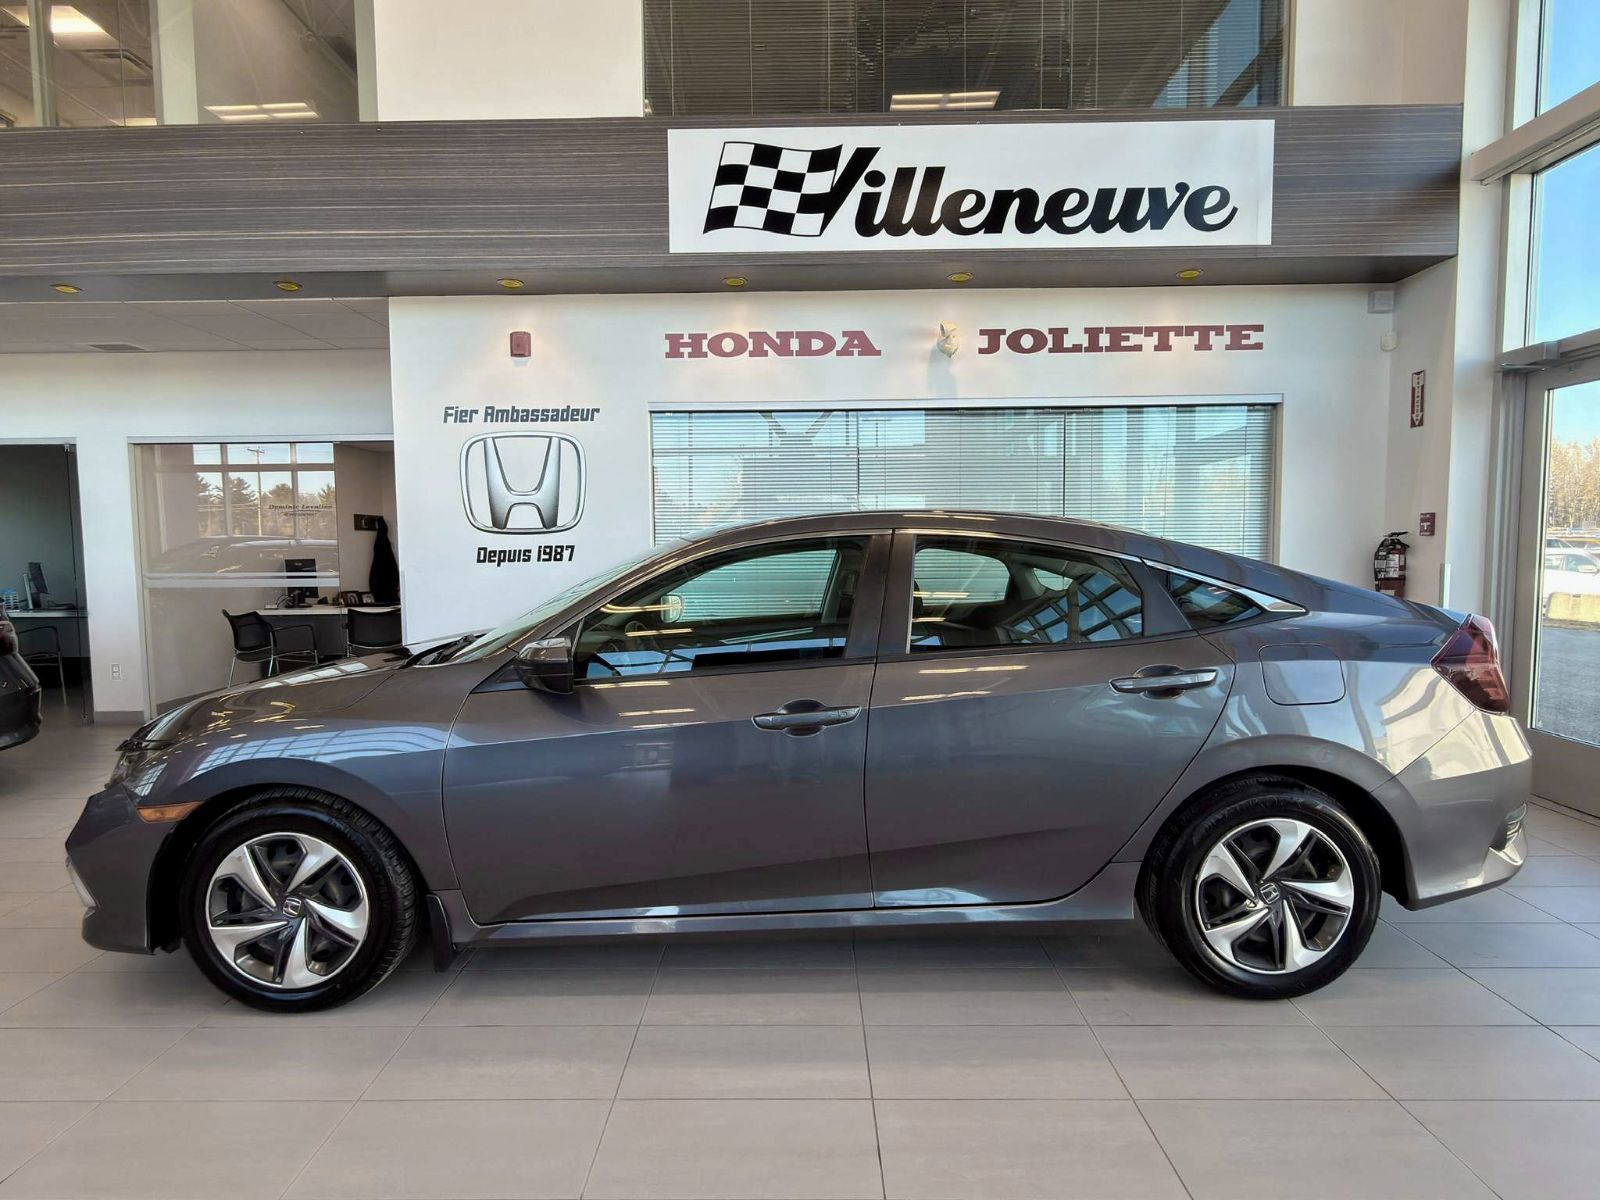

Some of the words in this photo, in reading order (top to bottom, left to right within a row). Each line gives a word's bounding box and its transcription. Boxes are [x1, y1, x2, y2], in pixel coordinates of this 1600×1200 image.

[818, 145, 1238, 238] Villeneuve
[665, 330, 881, 358] HONDA
[978, 324, 1264, 354] JOLIETTE
[443, 406, 478, 424] Fier
[483, 405, 600, 423] Ambassadeur
[476, 546, 531, 567] Depuis
[537, 545, 575, 563] 1987
